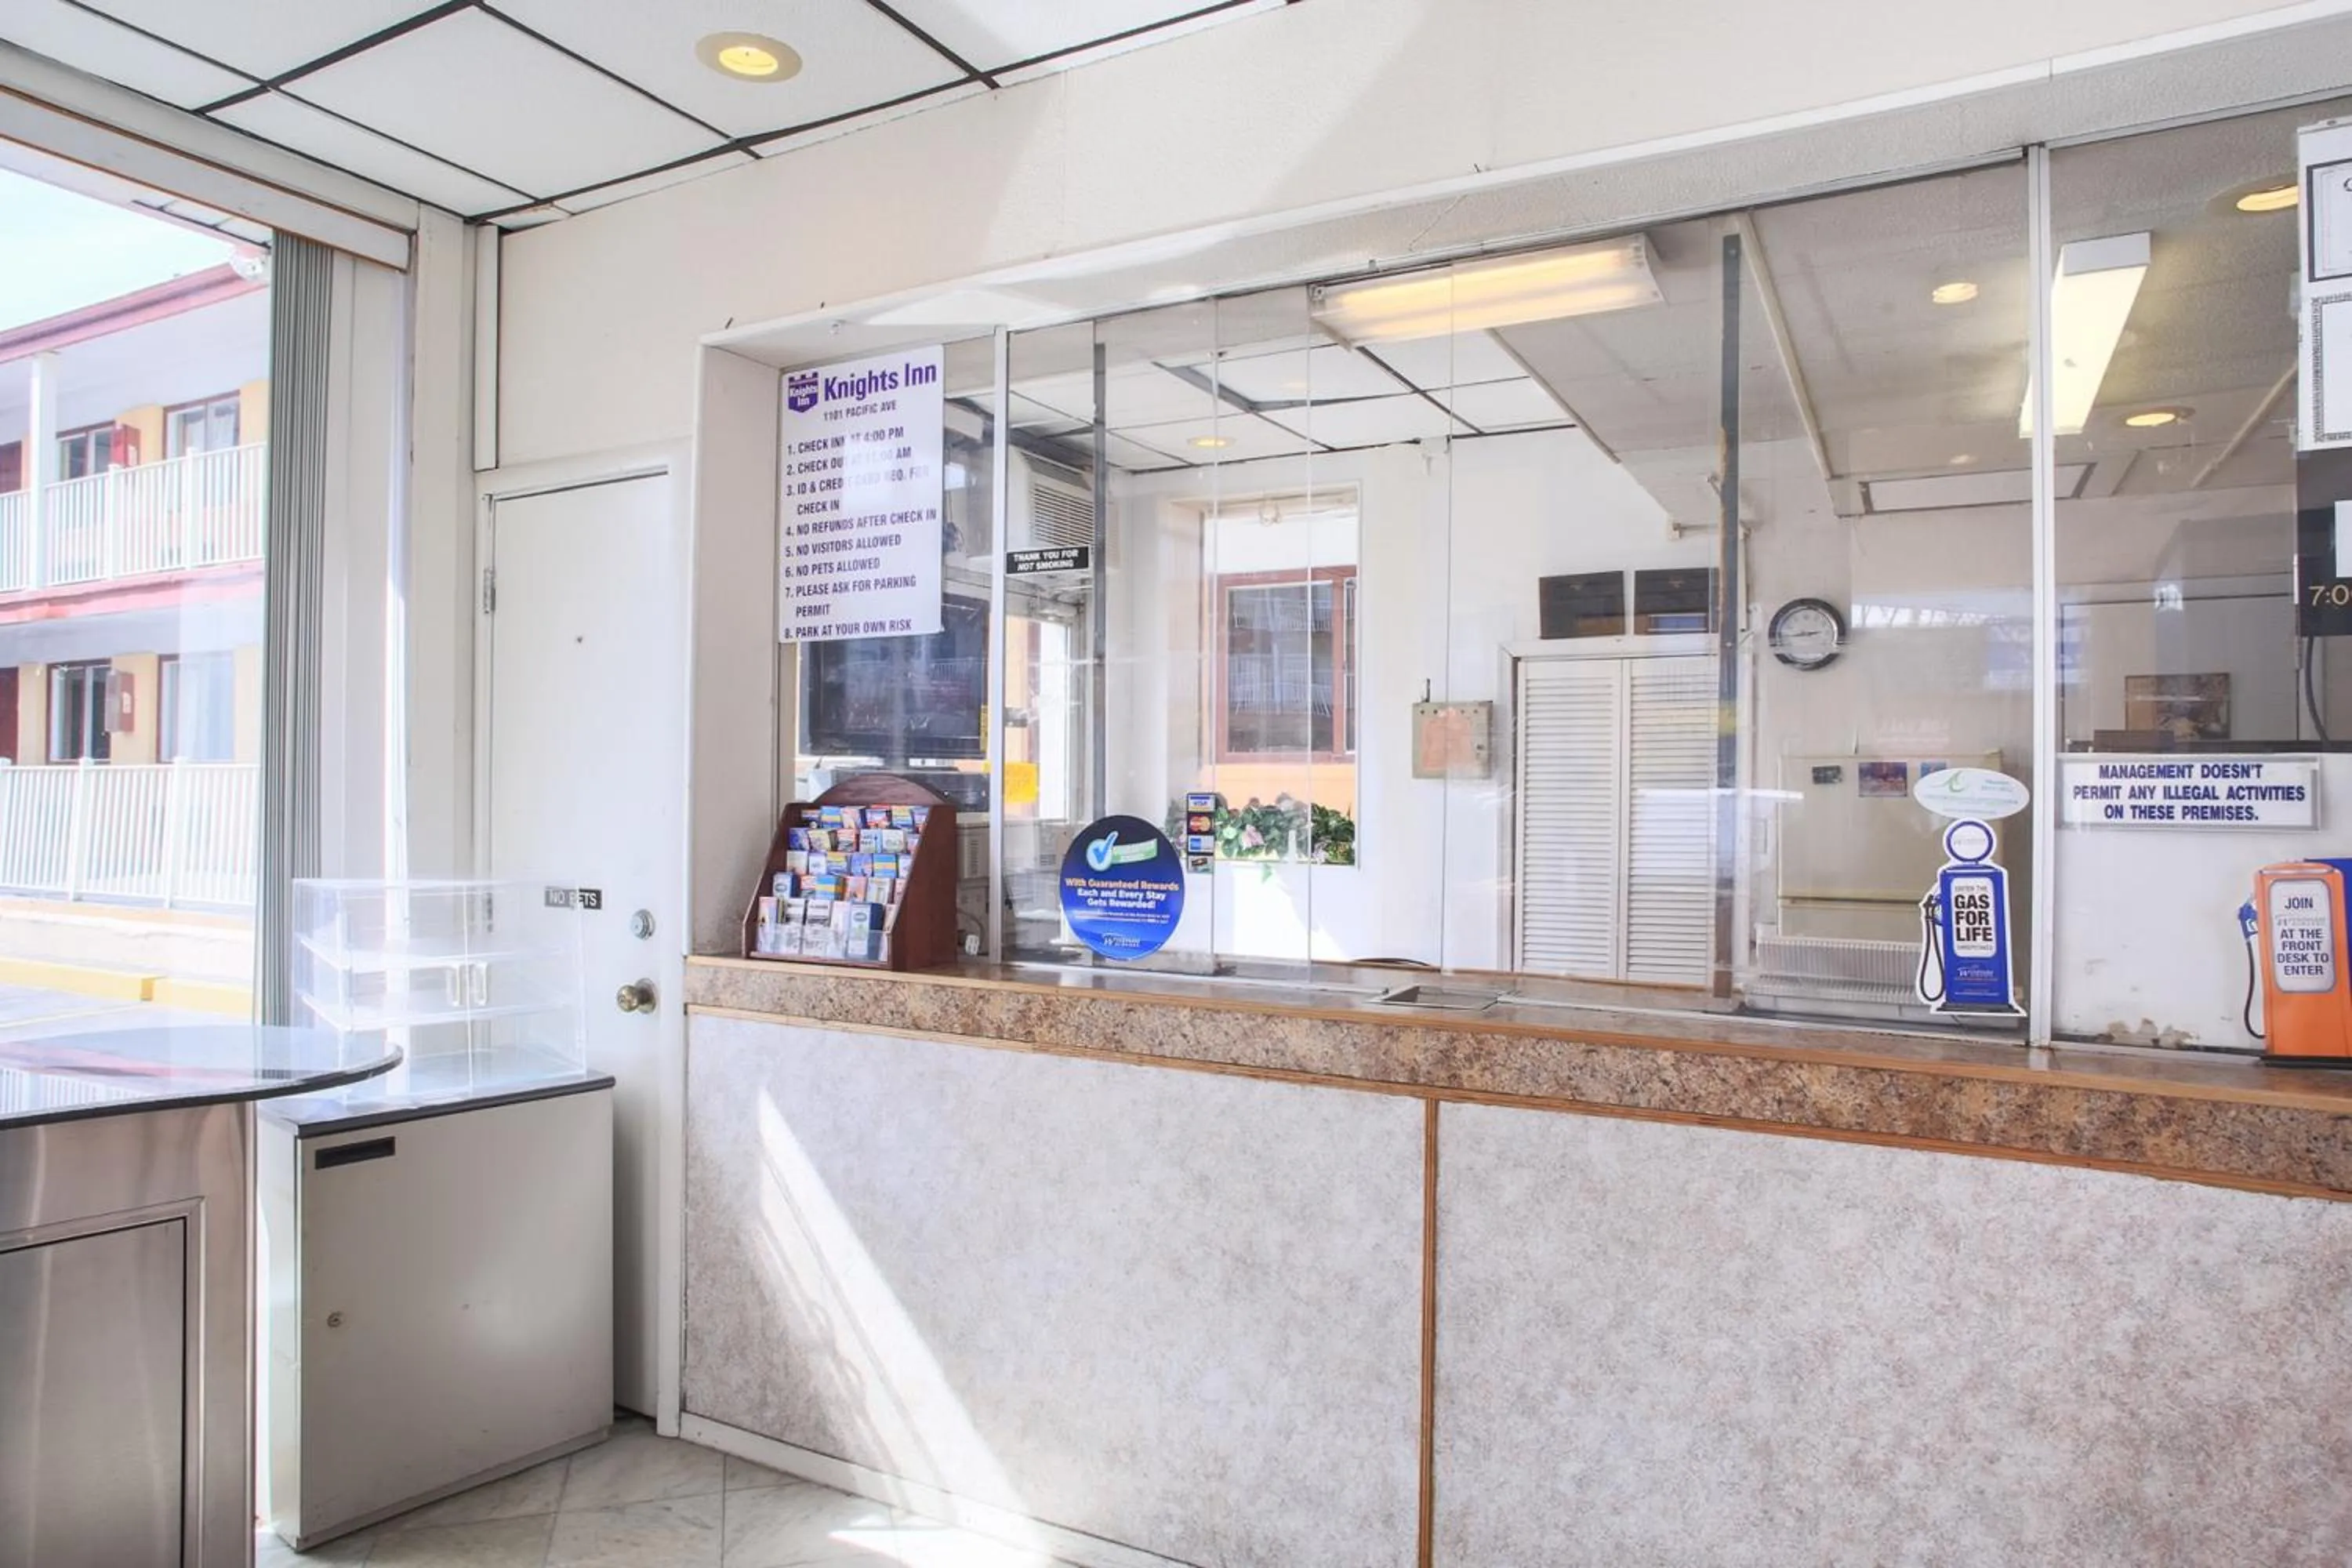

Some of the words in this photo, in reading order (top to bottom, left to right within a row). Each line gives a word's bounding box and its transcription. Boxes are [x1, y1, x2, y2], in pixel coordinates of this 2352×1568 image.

[825, 370, 899, 401] Knights
[905, 363, 937, 387] Inn
[797, 397, 810, 407] Inn
[824, 409, 843, 422] 1101
[846, 403, 877, 418] PACIFIC
[880, 401, 897, 412] AVE
[787, 445, 795, 455] 1.
[798, 438, 828, 454] CHECK
[864, 430, 885, 441] 4:00
[888, 426, 904, 439] PM
[786, 464, 795, 476] 2.
[797, 459, 828, 474] CHECK
[831, 455, 848, 469] OU
[896, 446, 911, 459] AM
[786, 485, 795, 495] 3.
[797, 482, 807, 495] ID
[810, 481, 816, 493] &
[797, 501, 828, 515] CHECK
[830, 499, 840, 511] IN
[786, 527, 794, 536] 4.
[796, 524, 810, 535] NO
[811, 517, 855, 534] REFUNDS
[857, 514, 887, 528] AFTER
[890, 510, 923, 524] CHECK
[926, 510, 937, 521] IN
[785, 547, 794, 557] 5.
[796, 545, 810, 557] NO
[811, 539, 855, 554] VISITORS
[856, 534, 902, 550] ALLOWED
[1014, 552, 1040, 562] THANK
[1042, 550, 1060, 560] YOU
[1061, 549, 1079, 558] FOR
[785, 567, 794, 578] 6.
[796, 565, 809, 577] NO
[811, 561, 835, 575] PETS
[837, 557, 880, 572] ALLOWED
[1017, 562, 1035, 571] NOT
[1036, 559, 1074, 570] SMOKING
[786, 587, 794, 599] 7.
[796, 583, 829, 597] PLEASE
[832, 581, 850, 593] ASK
[852, 579, 871, 592] FOR
[873, 575, 916, 590] PARKING
[2307, 585, 2352, 606] 7:0
[796, 604, 830, 618] PERMIT
[785, 628, 793, 639] 8.
[796, 626, 819, 639] PARK
[821, 624, 833, 636] AT
[835, 622, 861, 635] YOUR
[863, 621, 887, 633] OWN
[888, 619, 912, 632] RISK
[2099, 764, 2194, 779] MANAGEMENT
[2201, 764, 2263, 779] DOESN'T
[2073, 786, 2121, 800] PERMIT
[2128, 786, 2156, 800] ANY
[2163, 786, 2219, 800] ILLEGAL
[2227, 786, 2305, 800] ACTIVITIES
[2104, 804, 2124, 818] ON
[2130, 804, 2175, 819] THESE
[2182, 805, 2259, 821] PREMISES.
[1065, 878, 1087, 887] With
[1087, 879, 1139, 889] Guaranteed
[1141, 880, 1179, 891] Rewards
[550, 891, 565, 904] NO
[1101, 889, 1117, 898] and
[1119, 890, 1143, 902] Every
[1145, 891, 1167, 902] Stay
[1955, 895, 1990, 909] GAS
[1087, 898, 1107, 906] Gets
[1109, 898, 1156, 909] Rewarded!
[2284, 897, 2314, 909] JOIN
[1955, 911, 1990, 925] FOR
[1956, 927, 1993, 942] LIFE
[2281, 928, 2294, 938] AT
[2299, 928, 2323, 938] THE
[2281, 941, 2321, 951] FRONT
[2277, 953, 2310, 964] DESK
[2313, 953, 2329, 964] TO
[2284, 965, 2324, 976] ENTER
